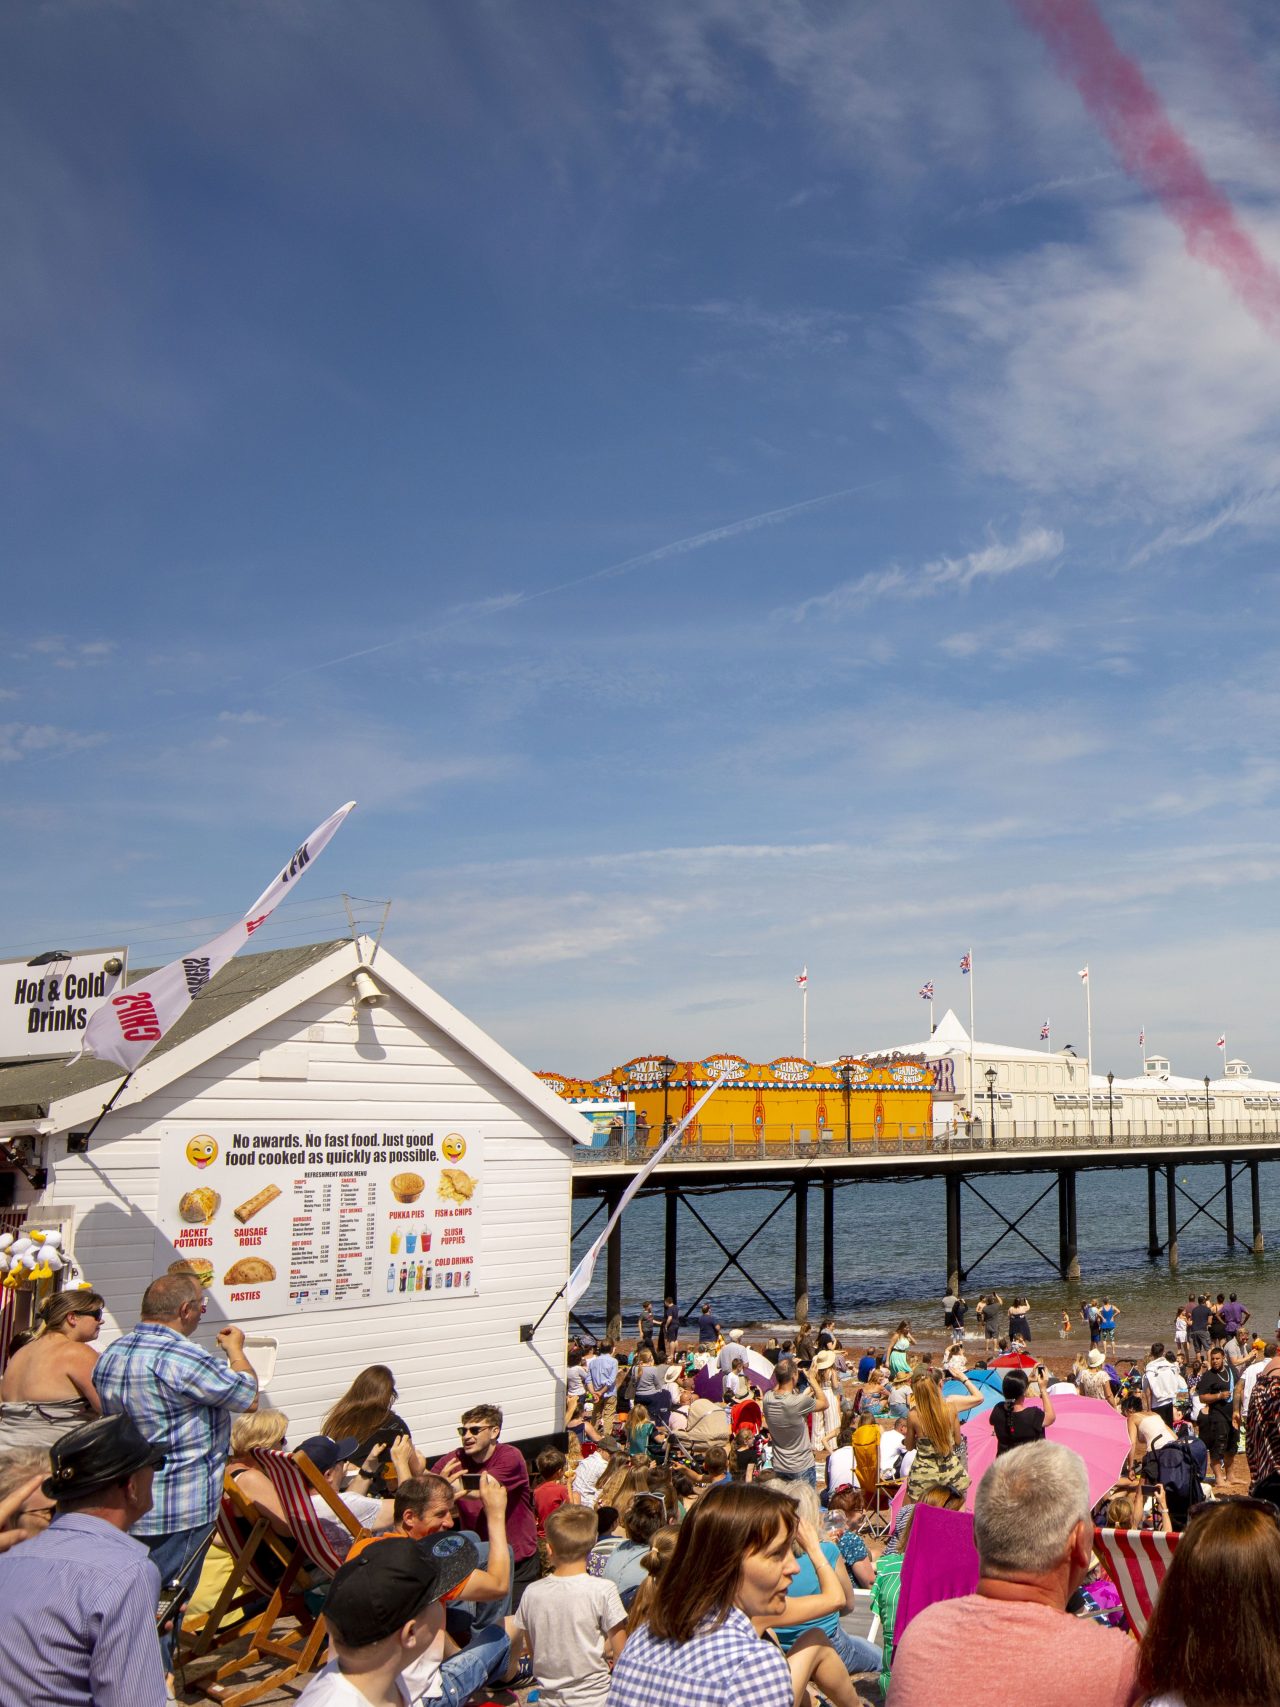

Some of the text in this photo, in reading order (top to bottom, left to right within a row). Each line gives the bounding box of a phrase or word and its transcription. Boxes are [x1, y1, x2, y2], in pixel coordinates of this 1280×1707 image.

[14, 971, 105, 1004] Hot & Cold
[28, 1005, 87, 1033] Drinks
[707, 1067, 719, 1077] OF
[780, 1061, 804, 1073] GIANT
[897, 1066, 919, 1076] GAMES
[774, 1070, 809, 1082] PRIZES
[893, 1073, 923, 1084] OF SKILL
[233, 1133, 434, 1148] No awards. No fast food. Just good
[225, 1149, 439, 1166] food cooked as quickly as possible.
[389, 1210, 425, 1219] PUKKA PIES
[435, 1208, 472, 1217] FISH & CHIPS
[180, 1228, 208, 1238] JACKET
[234, 1227, 268, 1237] SAUSAGE
[444, 1228, 463, 1237] SLUSH
[174, 1237, 213, 1248] POTATOES
[239, 1237, 262, 1247] ROLLS
[440, 1236, 466, 1245] PUPPIES
[435, 1256, 474, 1267] COLD DRINKS
[230, 1291, 261, 1302] PASTIES
